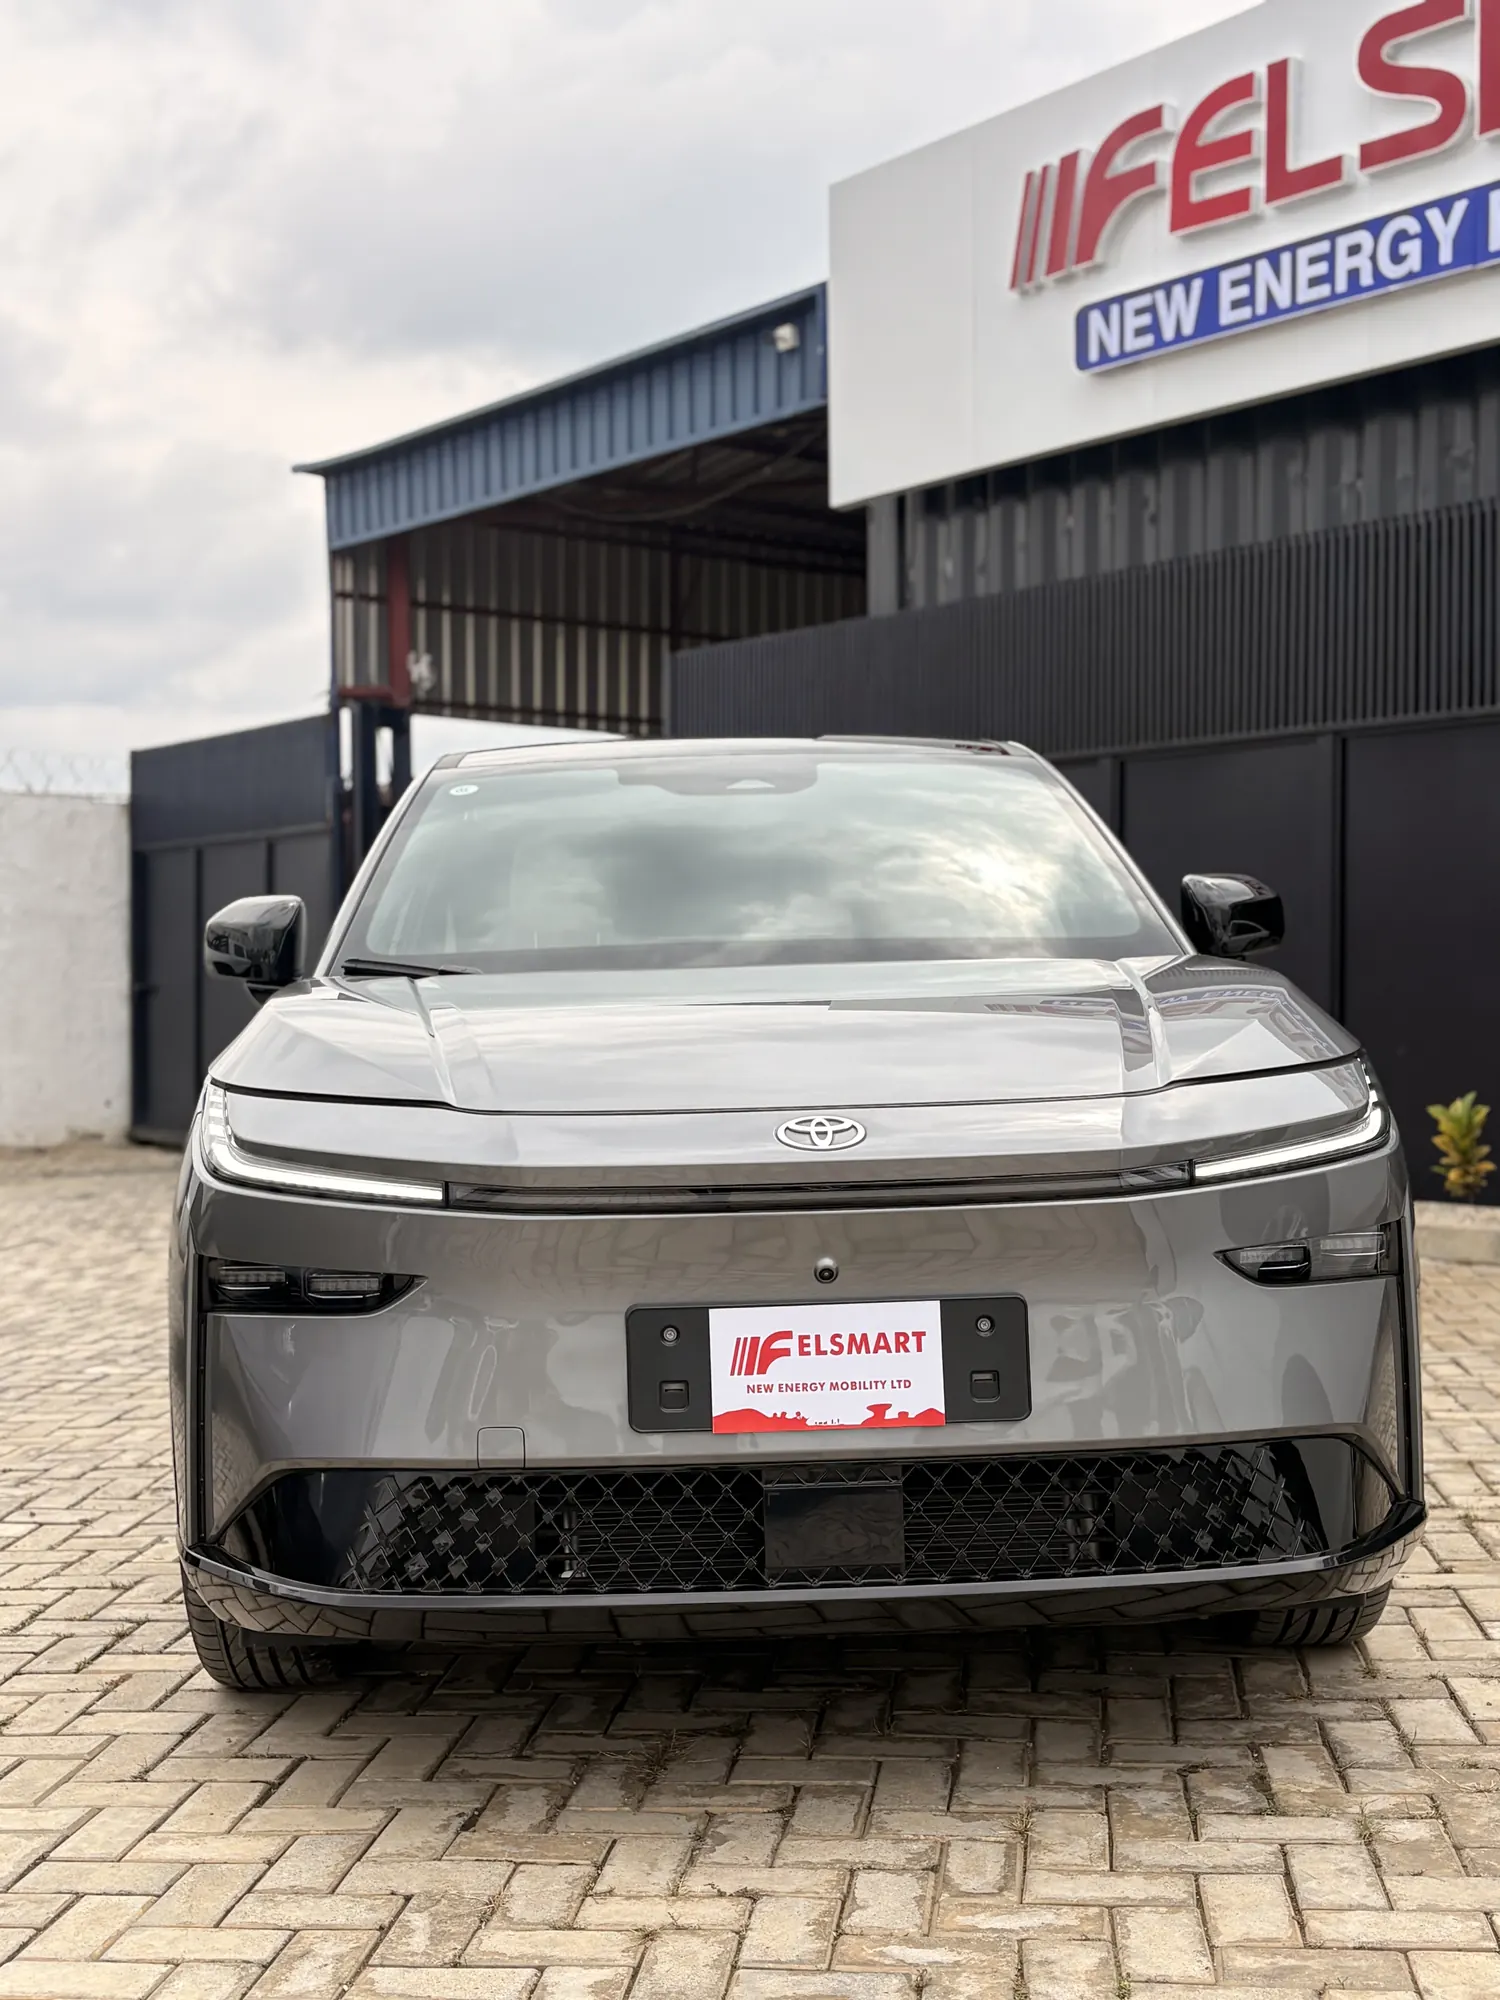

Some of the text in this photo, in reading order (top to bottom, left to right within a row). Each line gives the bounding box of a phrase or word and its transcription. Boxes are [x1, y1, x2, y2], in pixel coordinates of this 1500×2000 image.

[1073, 0, 1500, 265] FELS
[1088, 278, 1203, 363] NEW
[1219, 198, 1469, 326] ENERGY
[746, 1379, 912, 1394] NEW ENERGY MOBILITY LTD
